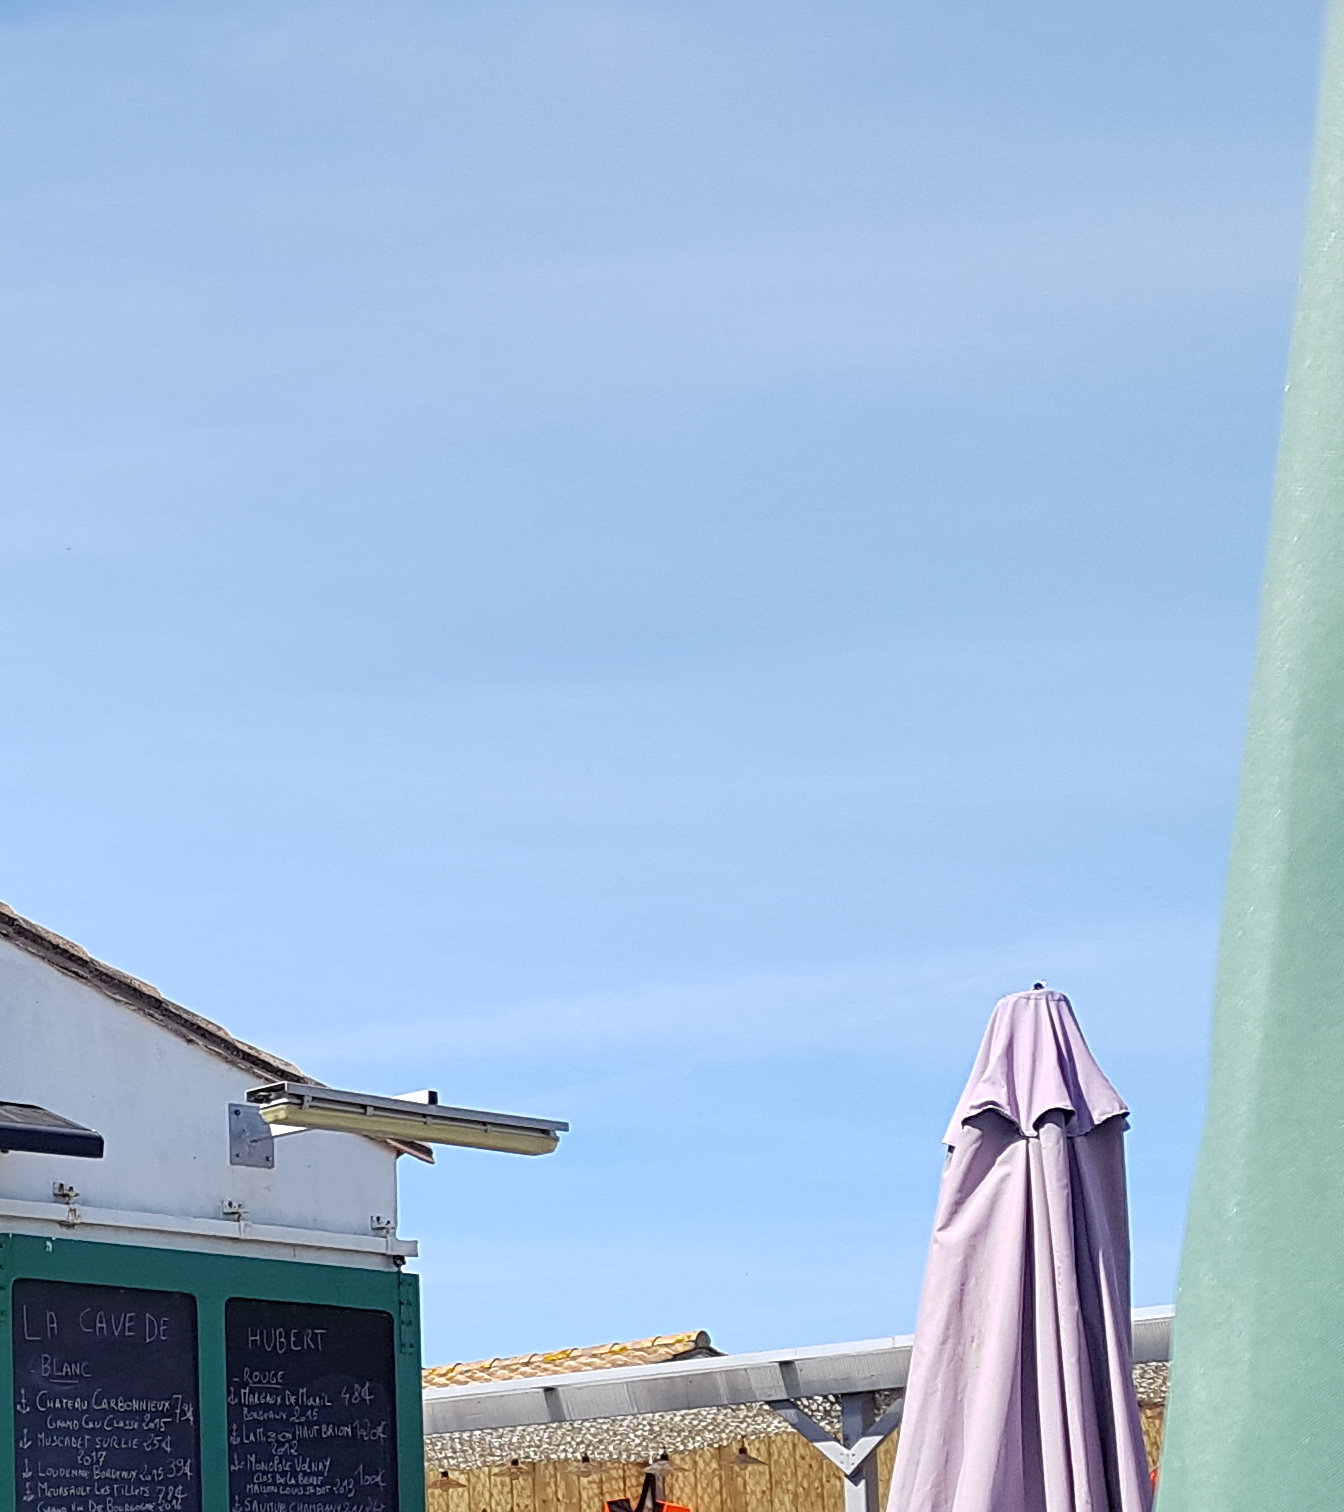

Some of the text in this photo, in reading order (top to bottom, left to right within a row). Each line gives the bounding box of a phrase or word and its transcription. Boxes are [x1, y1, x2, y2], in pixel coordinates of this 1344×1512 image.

[22, 1304, 170, 1344] LA CAVE DE
[248, 1327, 328, 1354] HUBERT
[41, 1353, 92, 1378] BLANC
[243, 1367, 285, 1384] ROUGE
[77, 1449, 107, 1467] 2017
